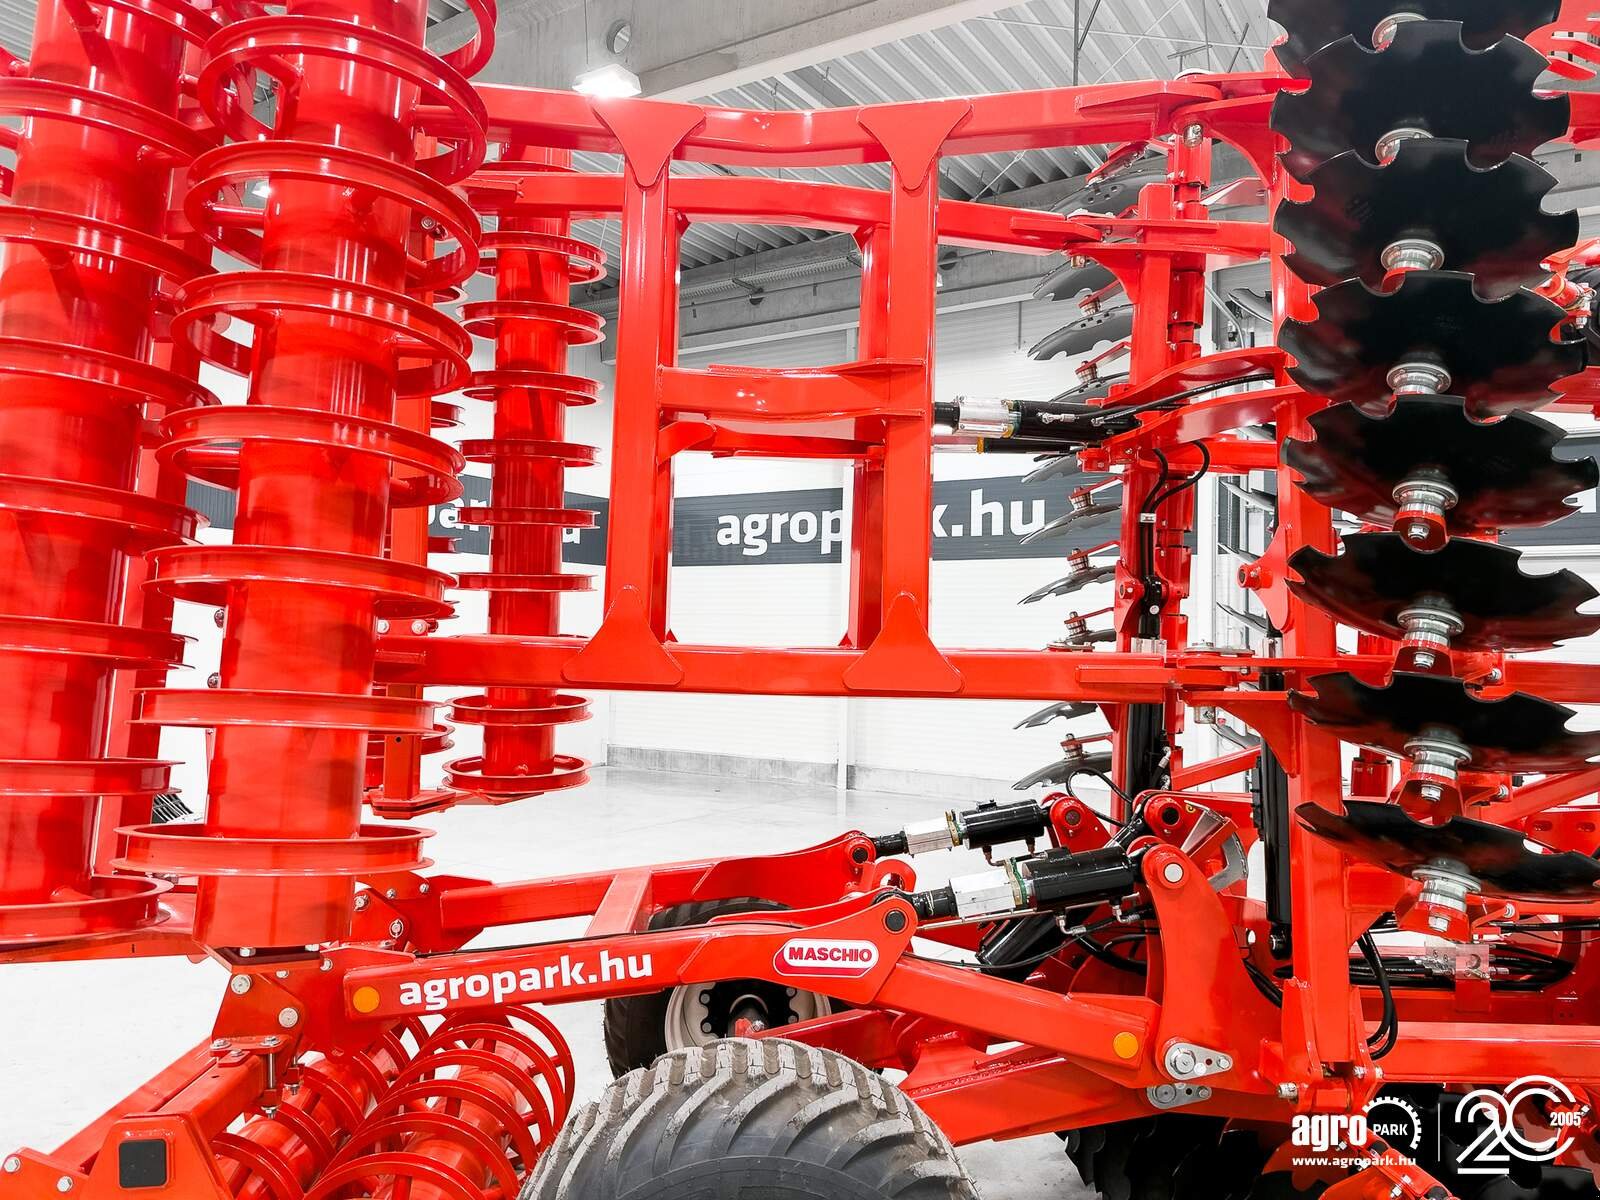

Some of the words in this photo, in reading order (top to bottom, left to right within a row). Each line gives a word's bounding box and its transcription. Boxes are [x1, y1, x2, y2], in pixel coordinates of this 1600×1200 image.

[716, 488, 1046, 556] agropk.hu
[399, 949, 653, 1011] agropark.hu
[788, 946, 873, 962] MASCHIO
